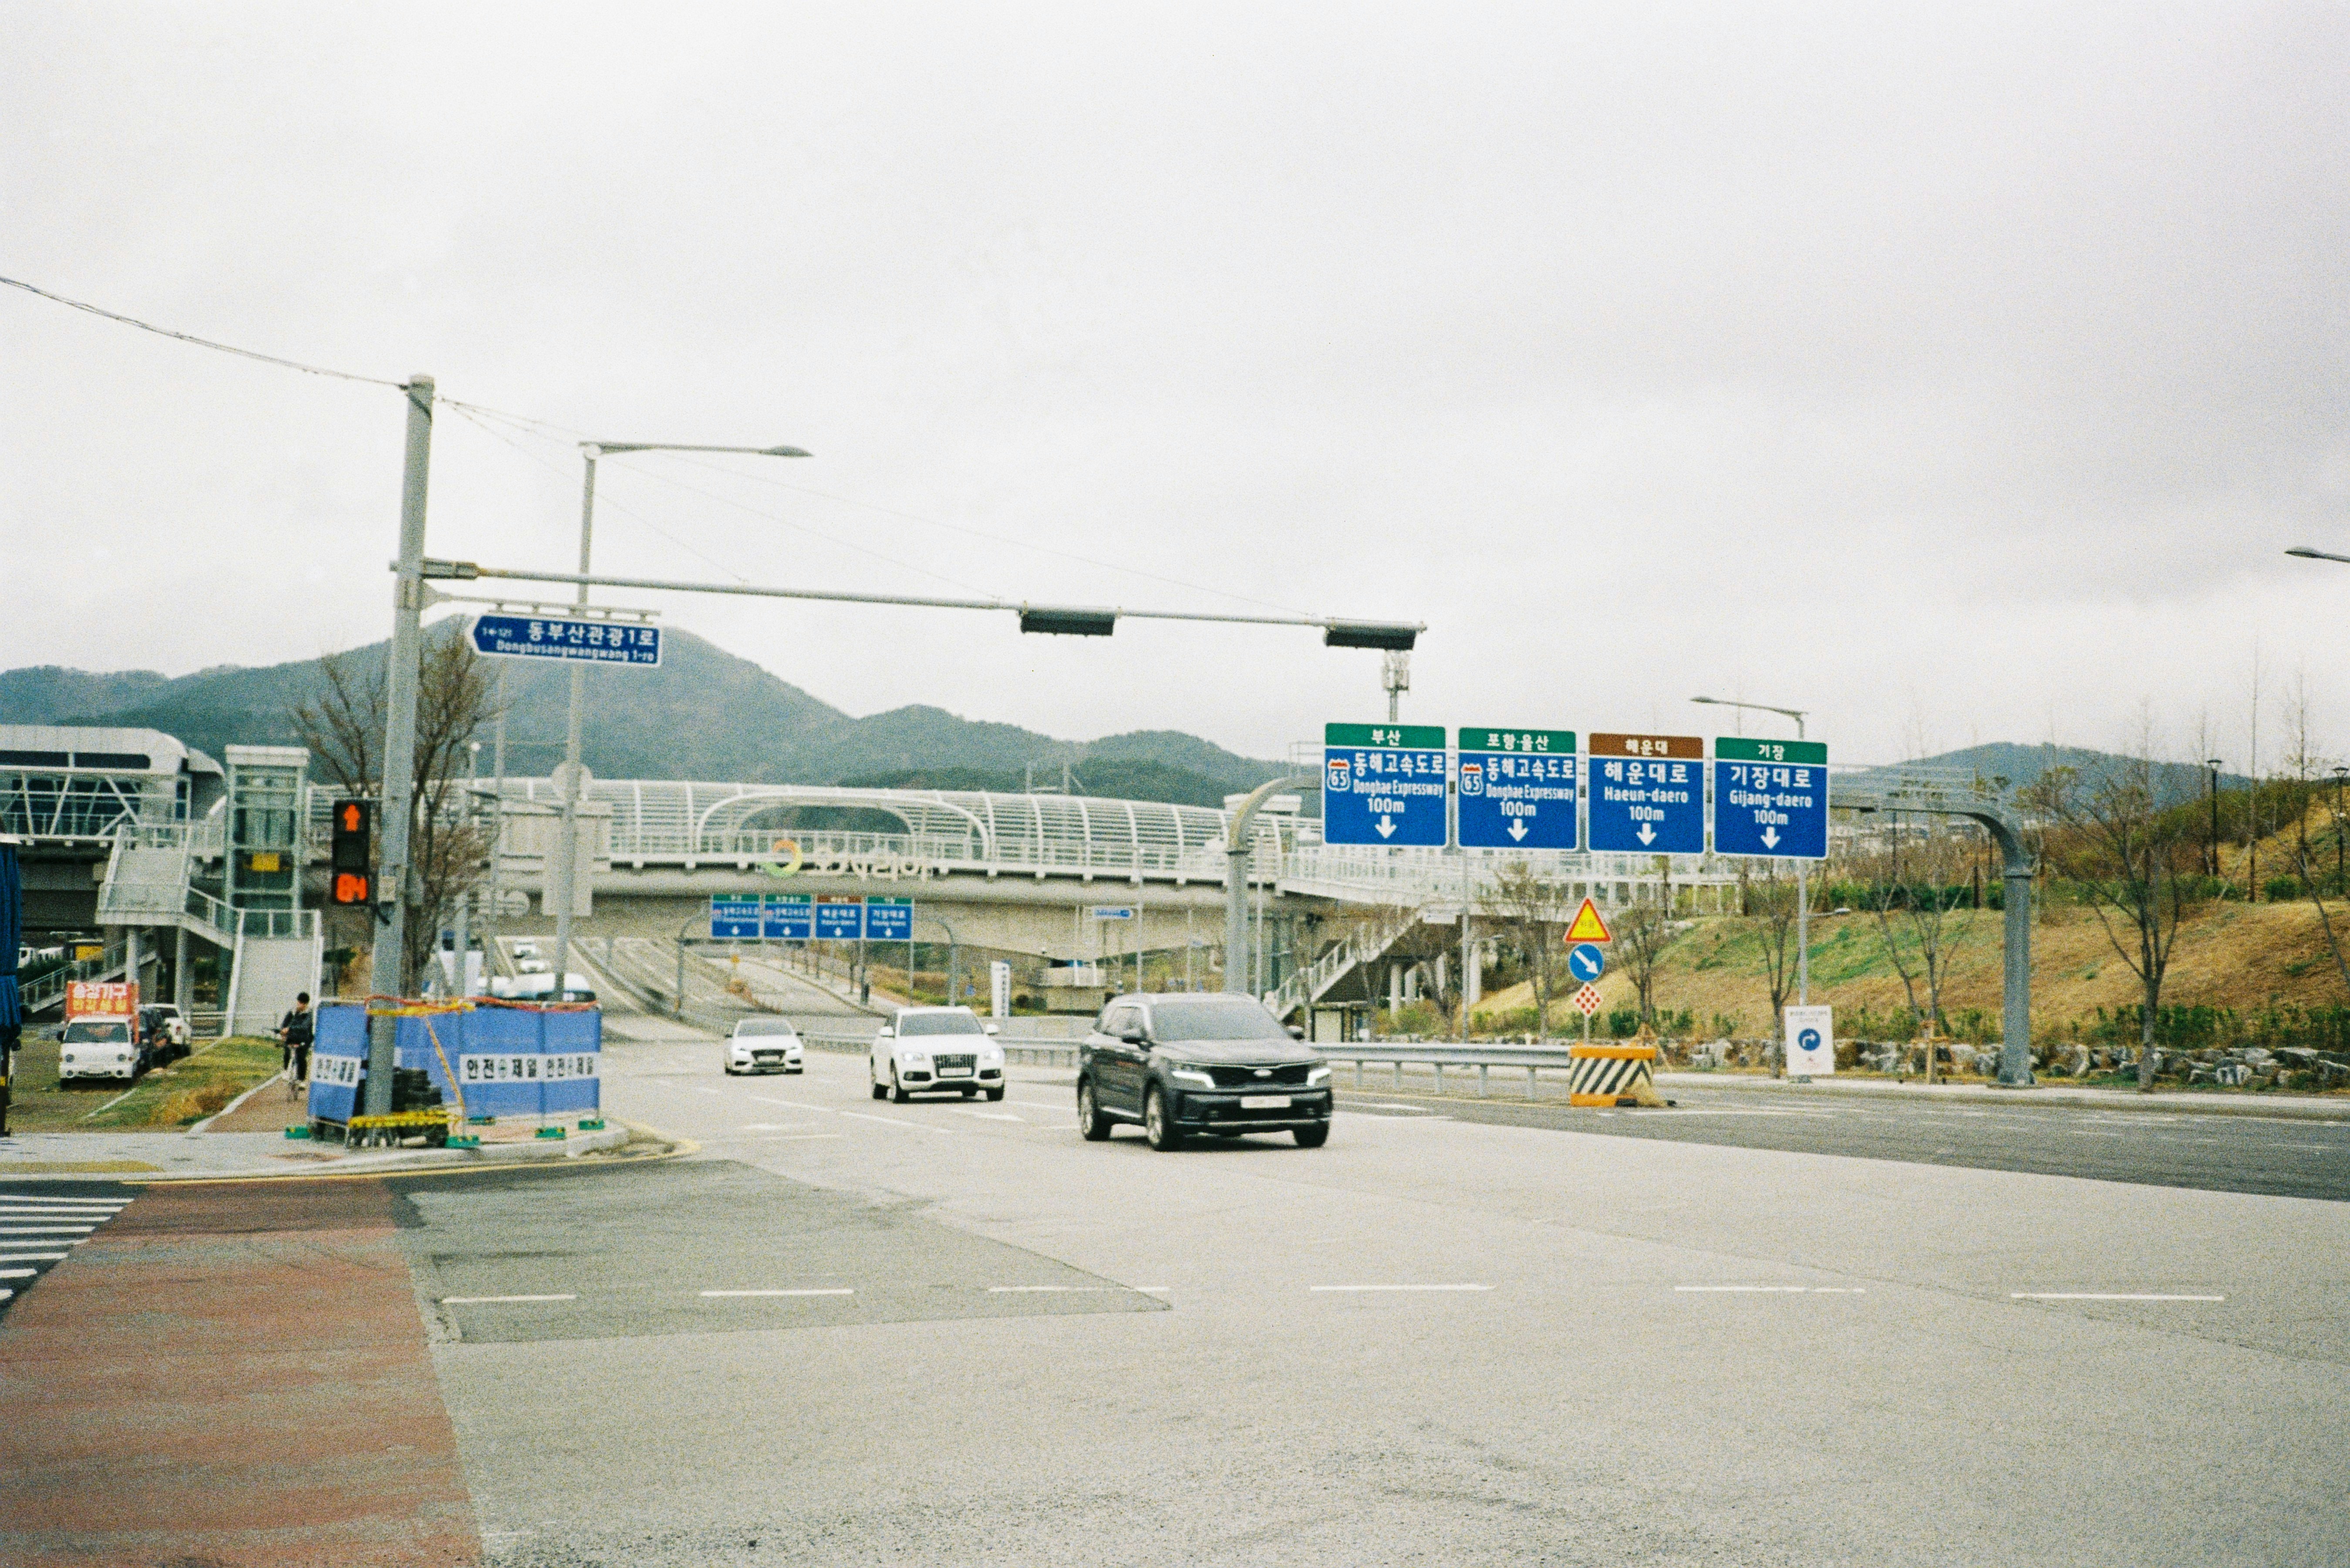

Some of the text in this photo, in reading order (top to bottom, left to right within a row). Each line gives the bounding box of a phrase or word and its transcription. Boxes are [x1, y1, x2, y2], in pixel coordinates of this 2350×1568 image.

[528, 621, 654, 647] 동부산관광1로
[1372, 729, 1401, 747] 부산
[1625, 739, 1668, 757] 해운대
[1758, 744, 1785, 760] 기장
[1354, 752, 1444, 777] 동해고속도로
[1487, 757, 1575, 781] 동해고속도로
[1605, 761, 1688, 785] 해운대로
[1331, 771, 1347, 786] 65
[1464, 775, 1480, 791] 65
[1730, 766, 1811, 790] 기장대로
[1354, 779, 1443, 798] Donghae Expressway
[1486, 783, 1574, 802] Donghae Expressway
[1605, 786, 1688, 803] Haeun-daero
[1368, 797, 1405, 813] 100m
[1730, 789, 1812, 808] Gijang-daero
[1500, 801, 1537, 817] 100m
[1629, 806, 1664, 821] 100m
[1754, 809, 1788, 825] 100m
[467, 1058, 494, 1079] 안전
